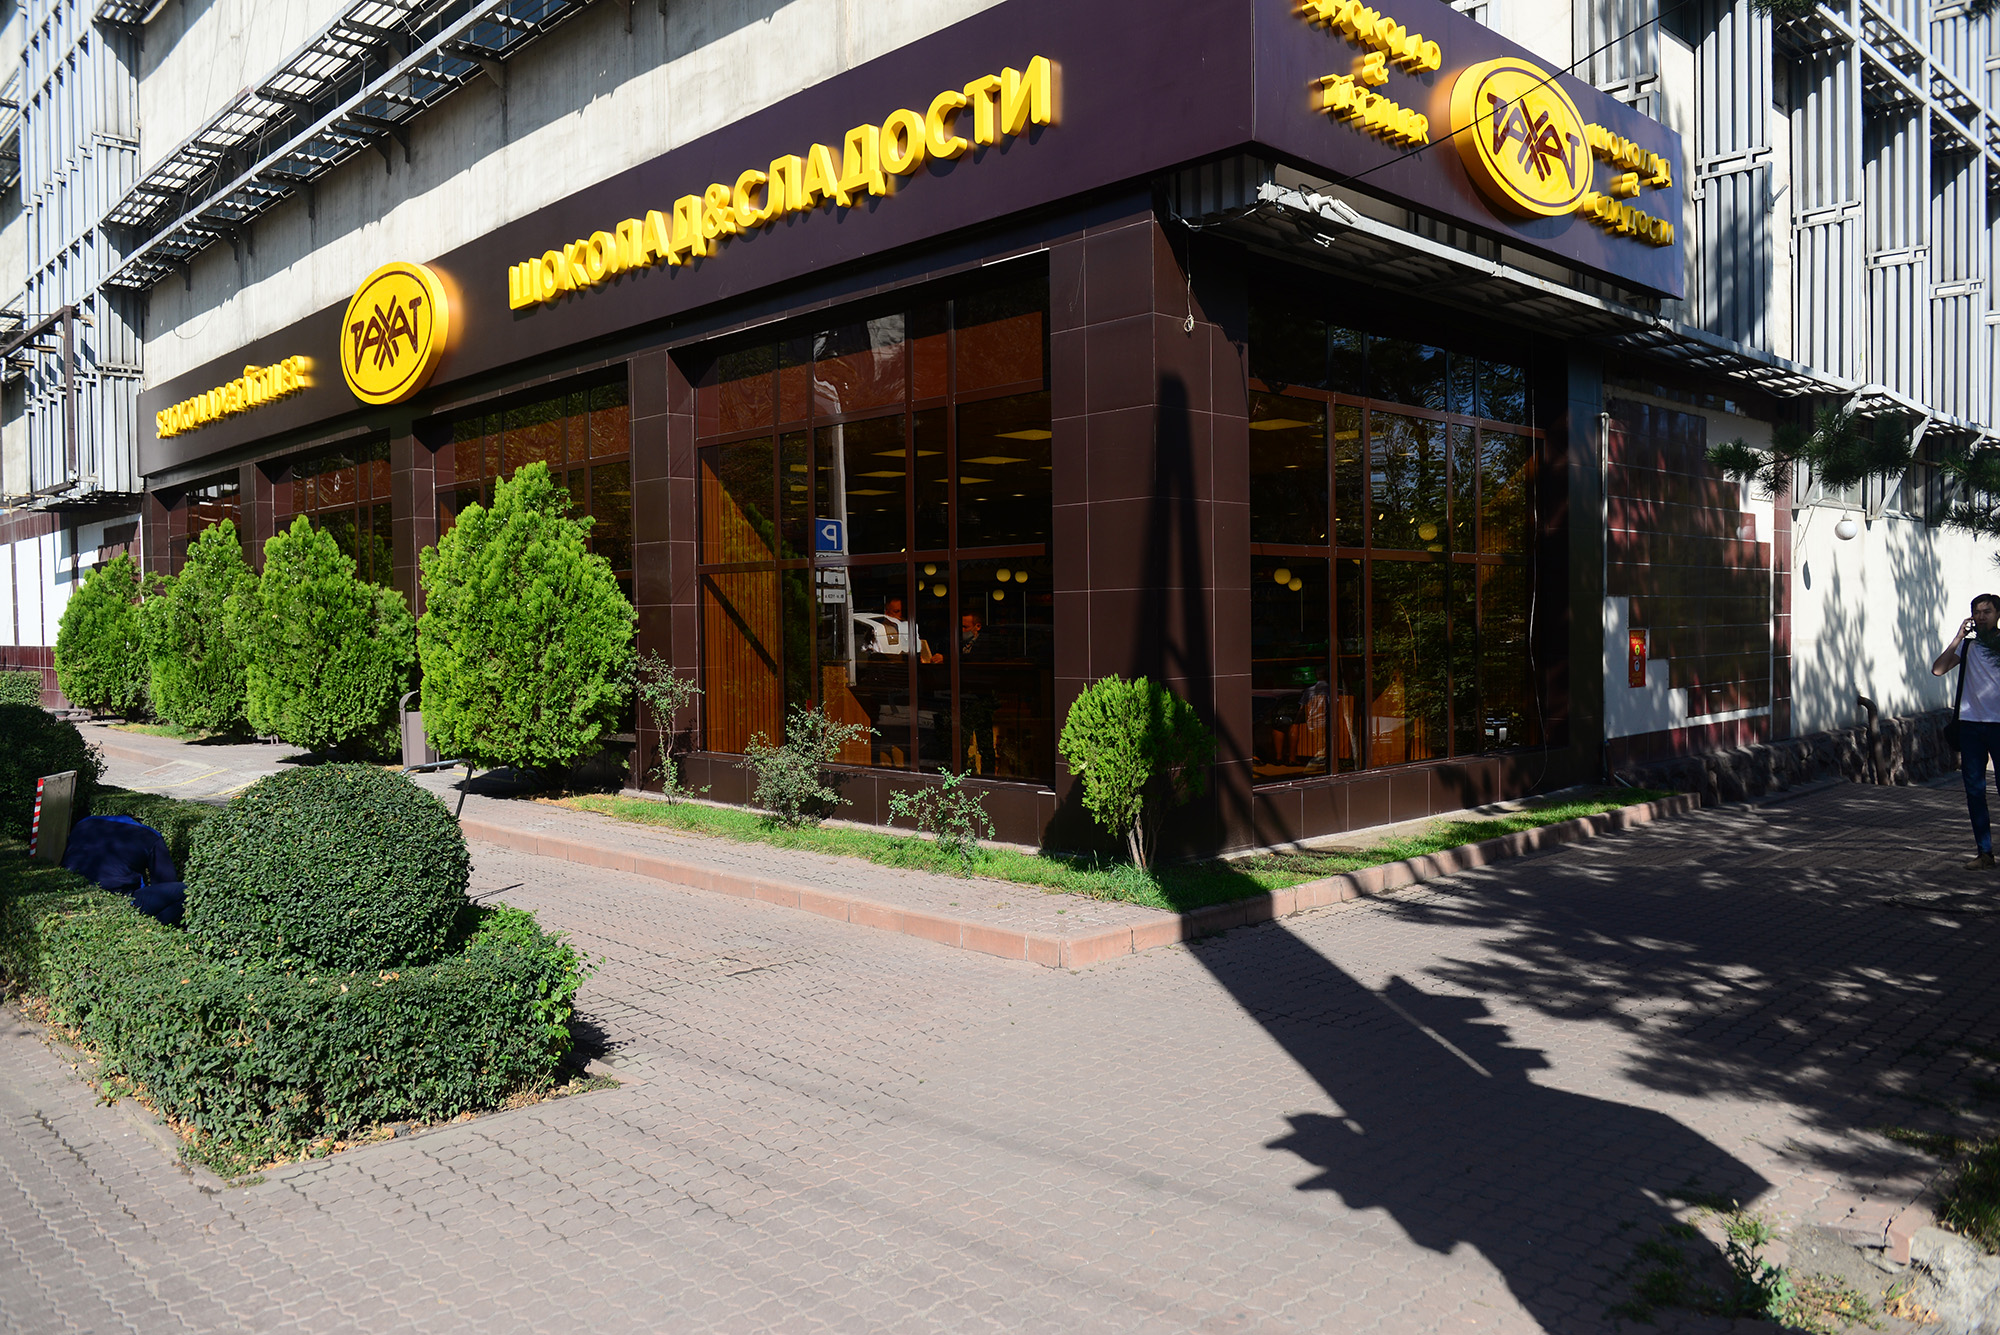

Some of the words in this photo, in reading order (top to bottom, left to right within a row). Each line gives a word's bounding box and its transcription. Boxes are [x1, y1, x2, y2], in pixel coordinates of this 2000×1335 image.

[1362, 51, 1389, 86] &
[1585, 123, 1672, 187] ШОКОЛАД
[1621, 172, 1640, 197] &
[1584, 191, 1674, 247] СЛАДОСТИ
